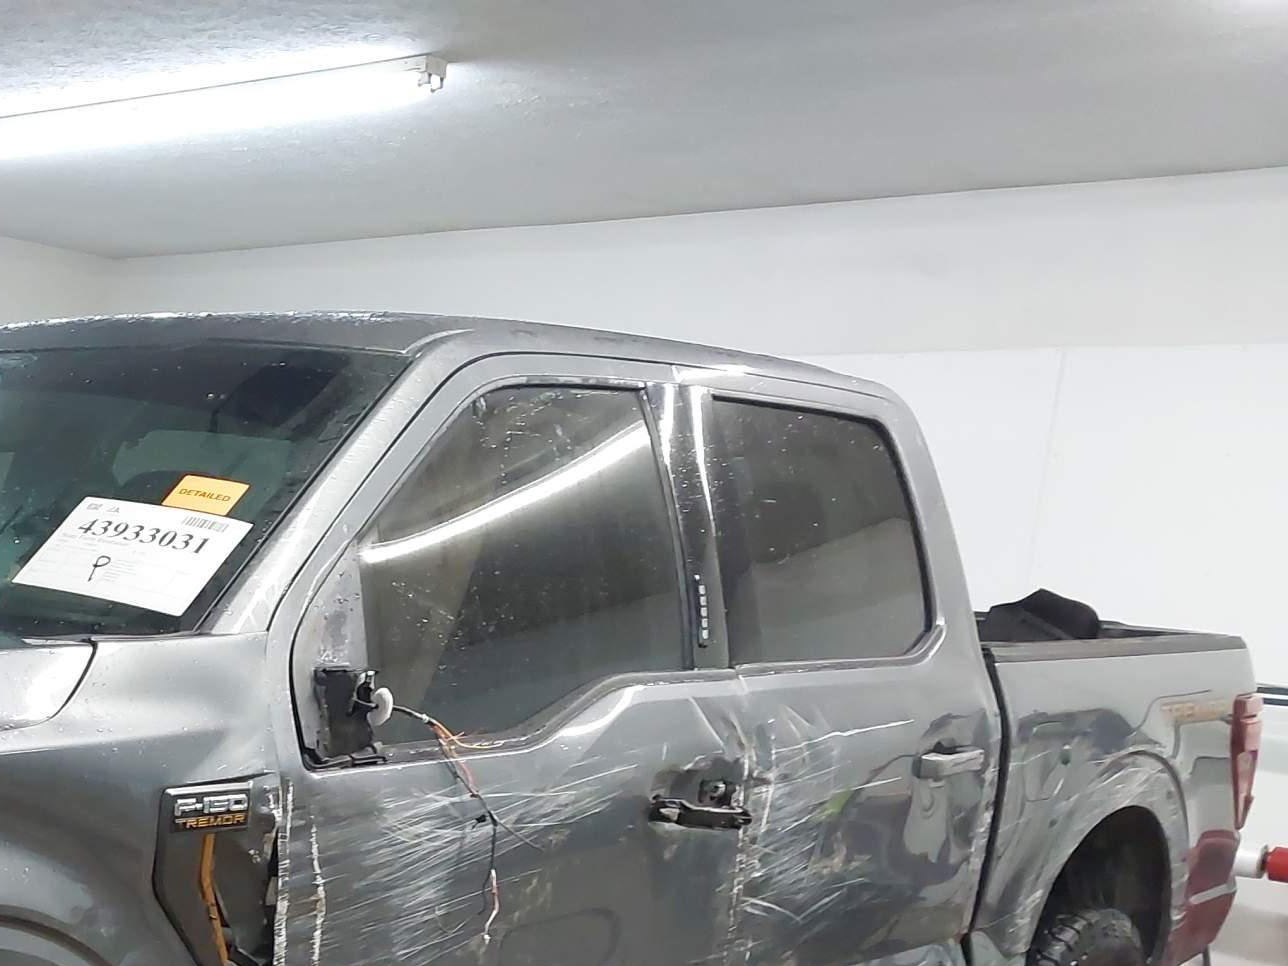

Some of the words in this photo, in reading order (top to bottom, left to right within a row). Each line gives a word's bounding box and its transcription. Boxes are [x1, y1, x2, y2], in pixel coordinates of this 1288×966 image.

[178, 488, 231, 502] DETAILED
[78, 518, 211, 554] 43933031
[174, 793, 248, 817] F-150
[174, 813, 246, 829] TREMOR
